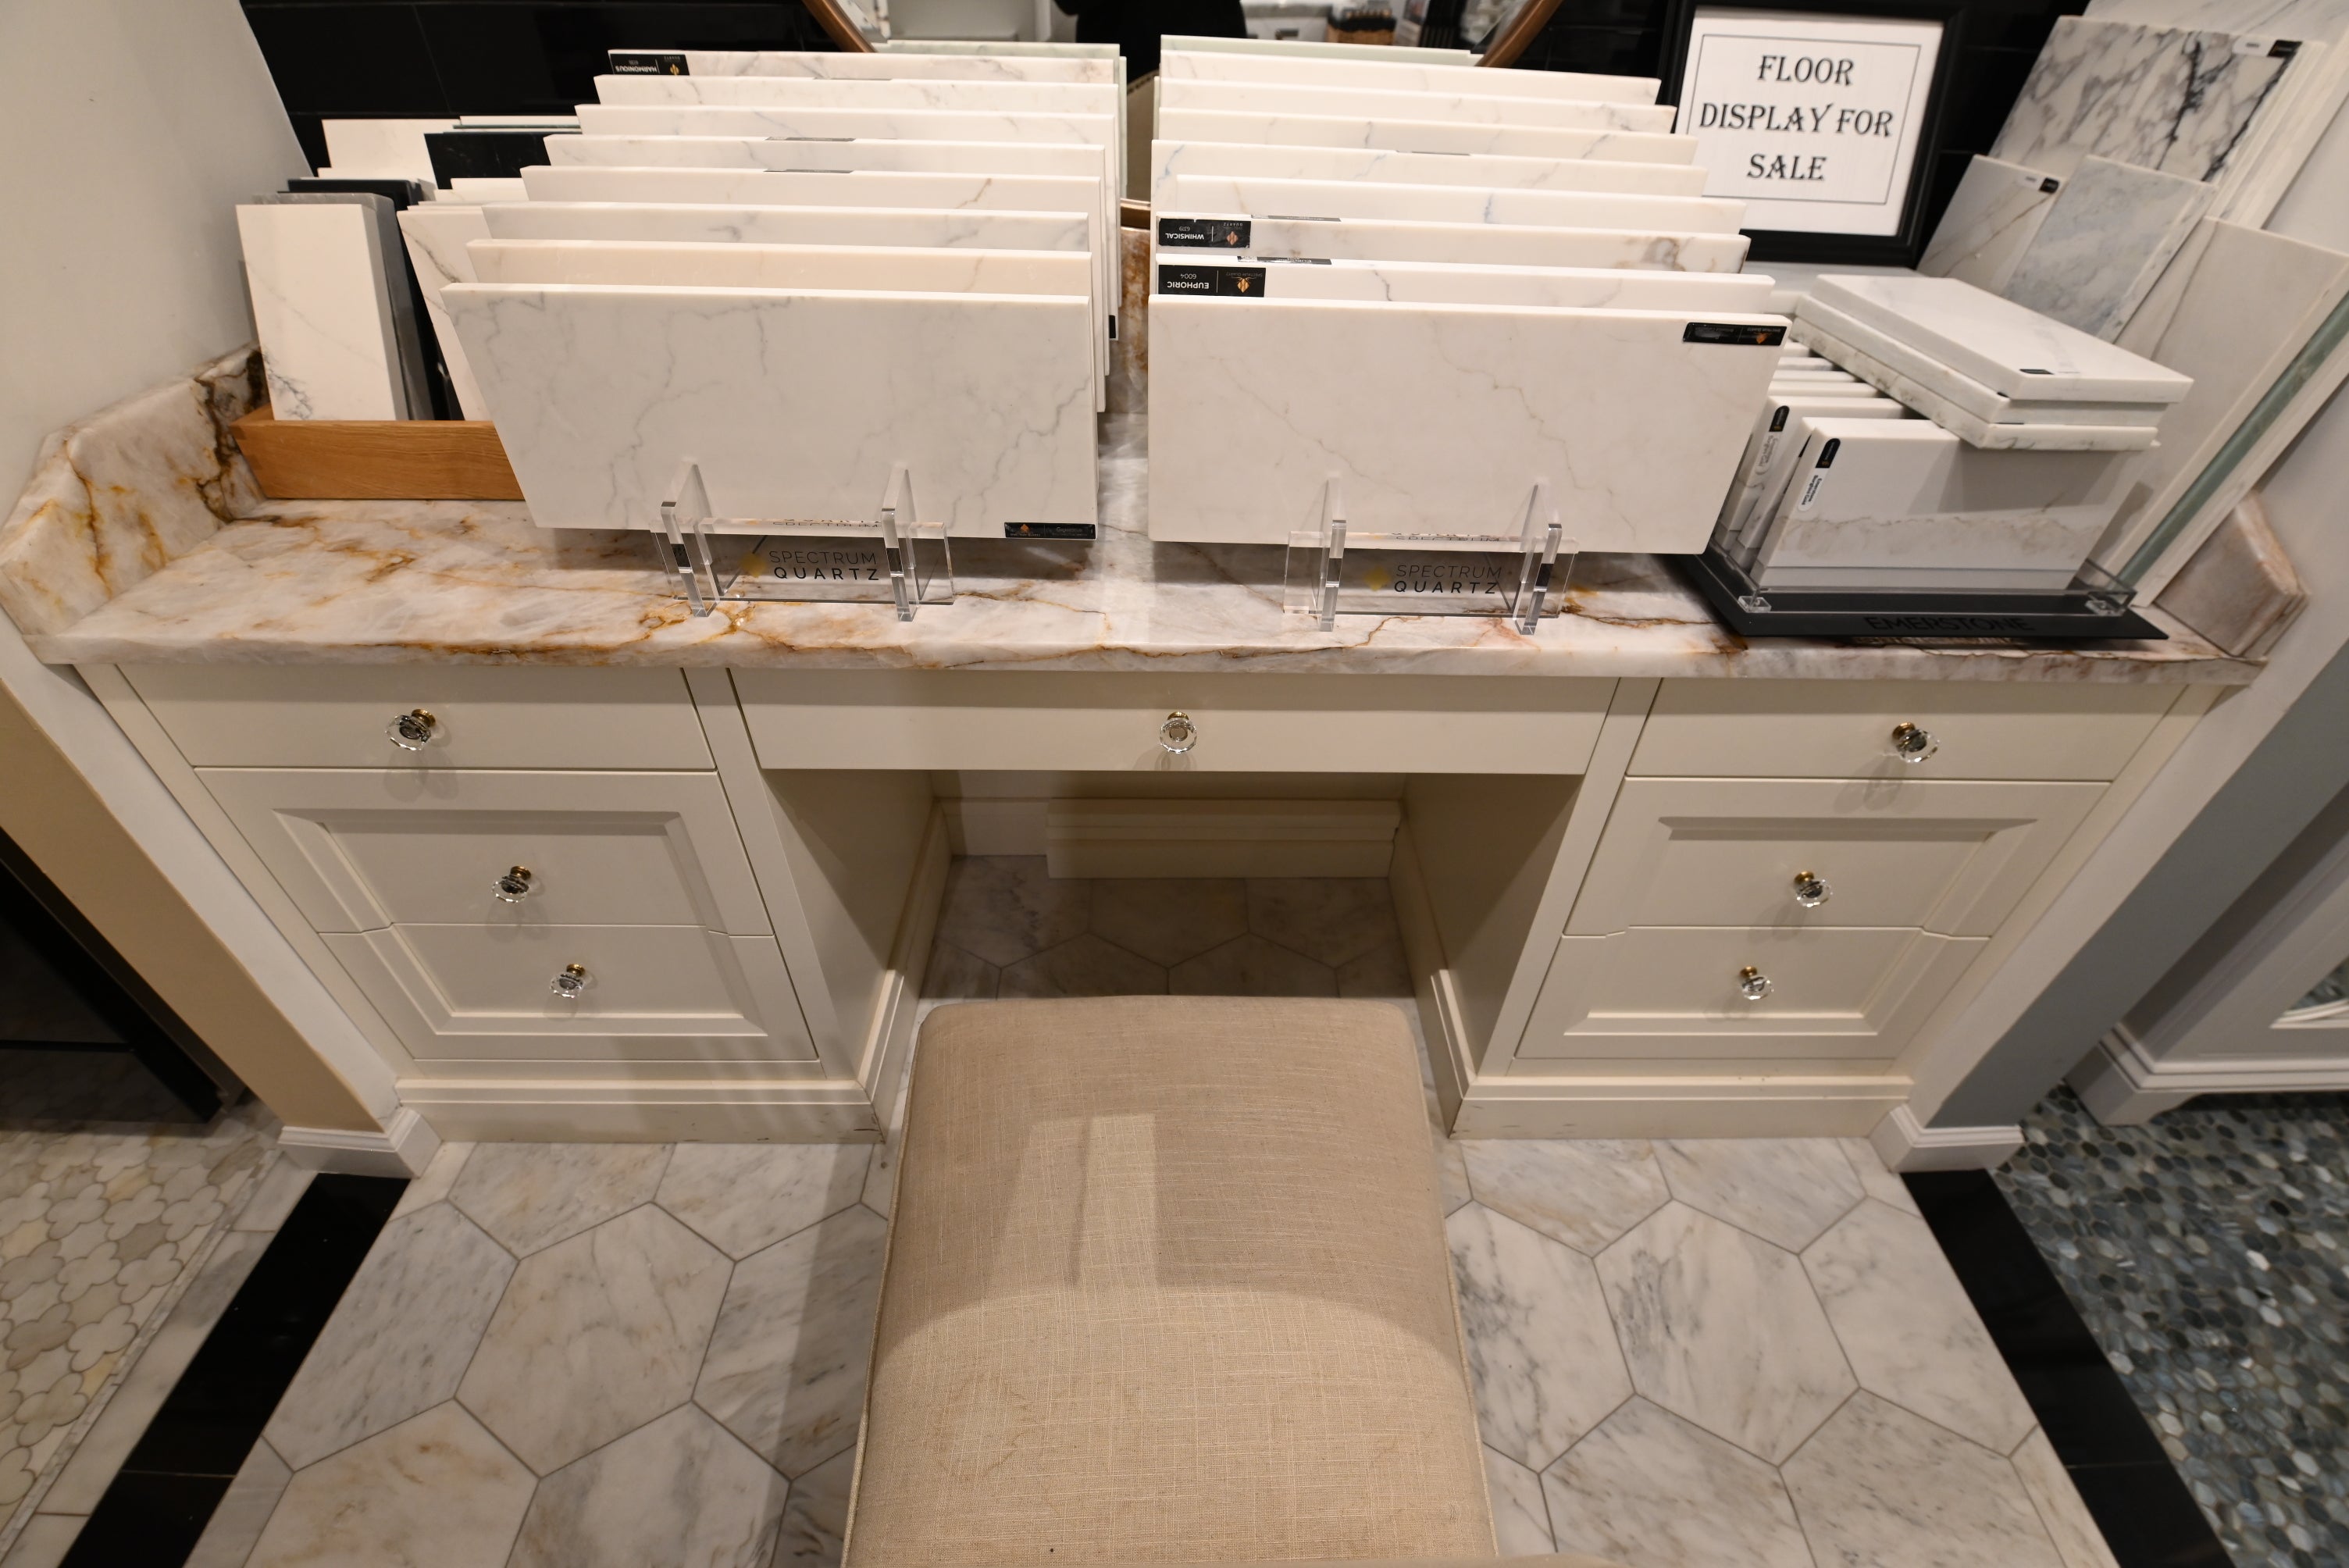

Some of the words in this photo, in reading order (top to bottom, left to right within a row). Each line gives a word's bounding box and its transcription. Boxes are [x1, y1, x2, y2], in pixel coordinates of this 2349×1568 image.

[1757, 55, 1855, 87] FLOOR
[1699, 102, 1834, 133] DISPLAY
[1836, 109, 1894, 137] FOR
[1747, 153, 1827, 180] SALE
[769, 551, 876, 565] SPECTRUM
[773, 567, 879, 581] QUARTZ
[1395, 565, 1502, 579] SPECTRUM
[1394, 580, 1498, 594] QUARTZ
[1864, 617, 2035, 631] EMERSTONE
